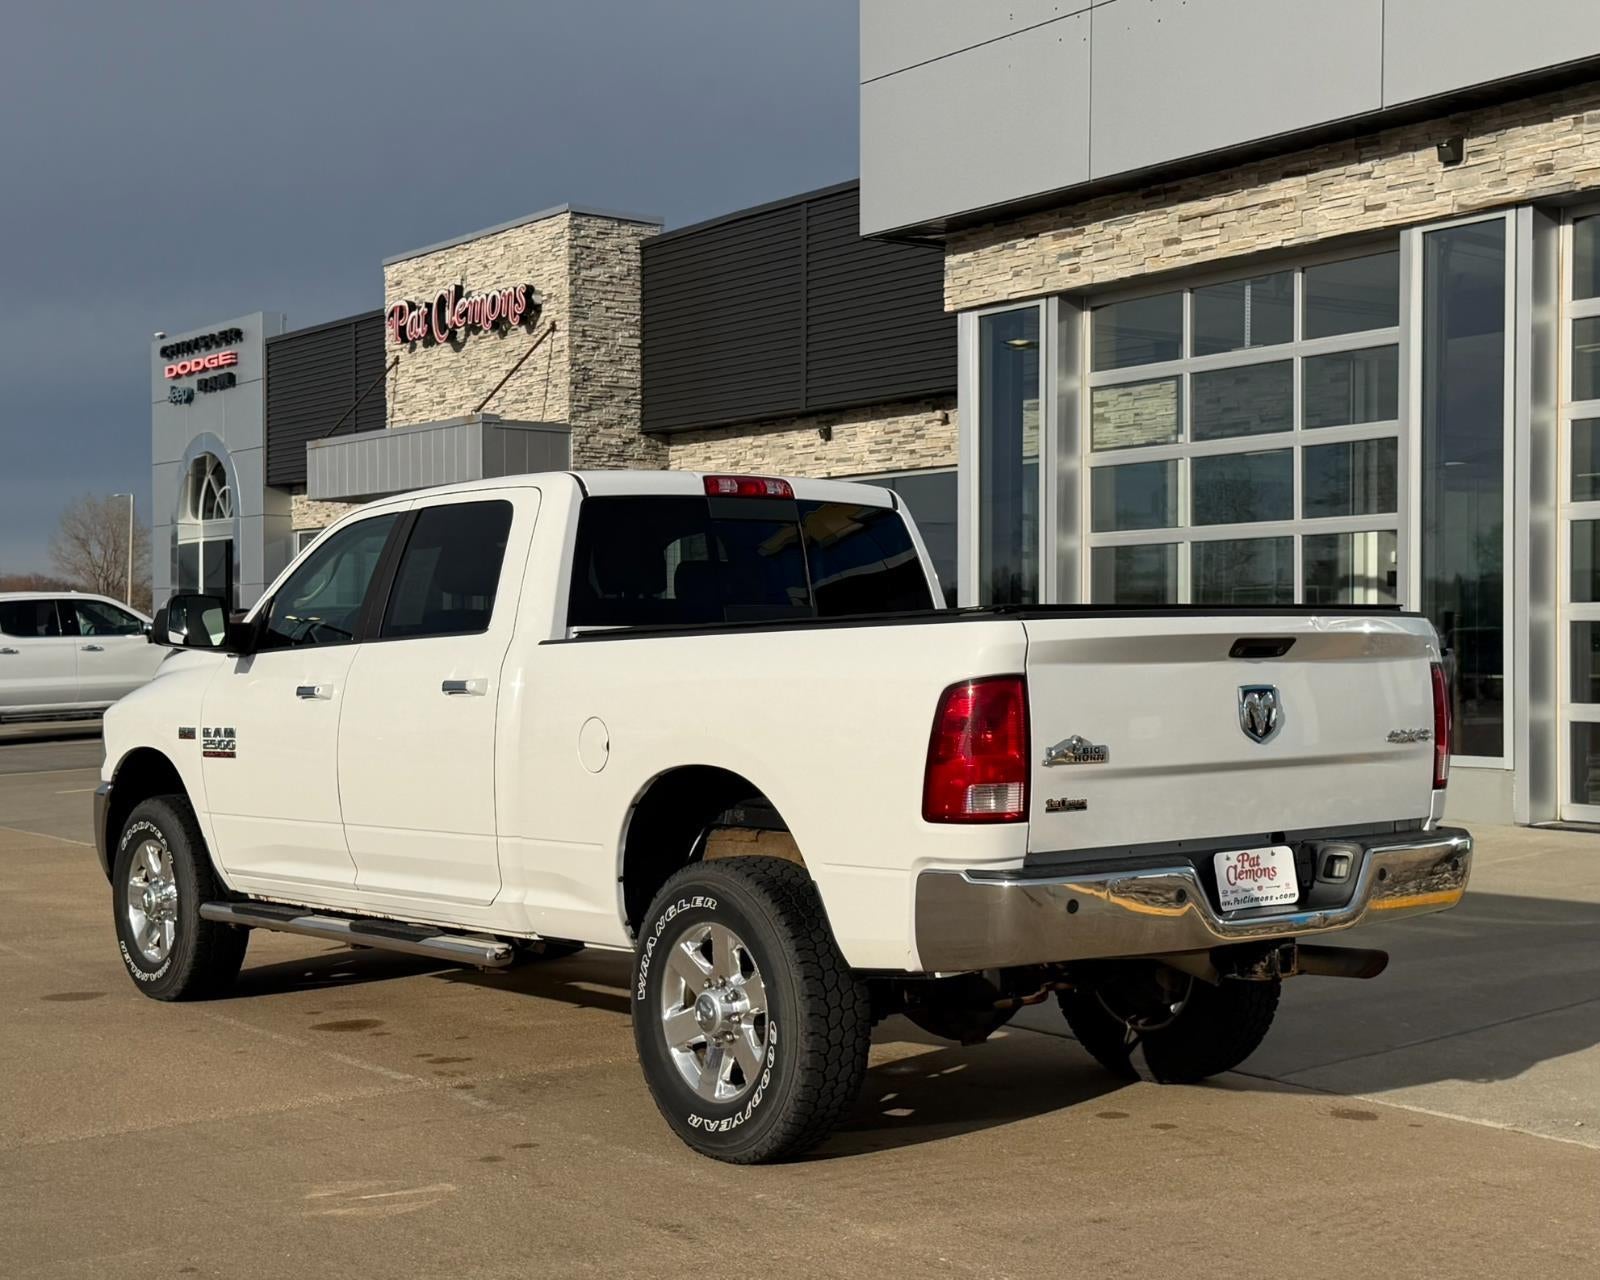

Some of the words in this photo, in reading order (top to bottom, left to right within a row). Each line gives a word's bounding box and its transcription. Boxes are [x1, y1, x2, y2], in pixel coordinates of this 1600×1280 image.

[387, 300, 428, 344] Pat
[432, 283, 527, 344] Clemons
[164, 350, 238, 379] DODGE
[1074, 754, 1105, 762] HORN
[1083, 746, 1102, 755] BIG
[1236, 852, 1261, 869] Pat
[1226, 864, 1278, 887] Clemons
[637, 896, 718, 1000] WRANGLER
[687, 1020, 778, 1132] GOODYEAR
